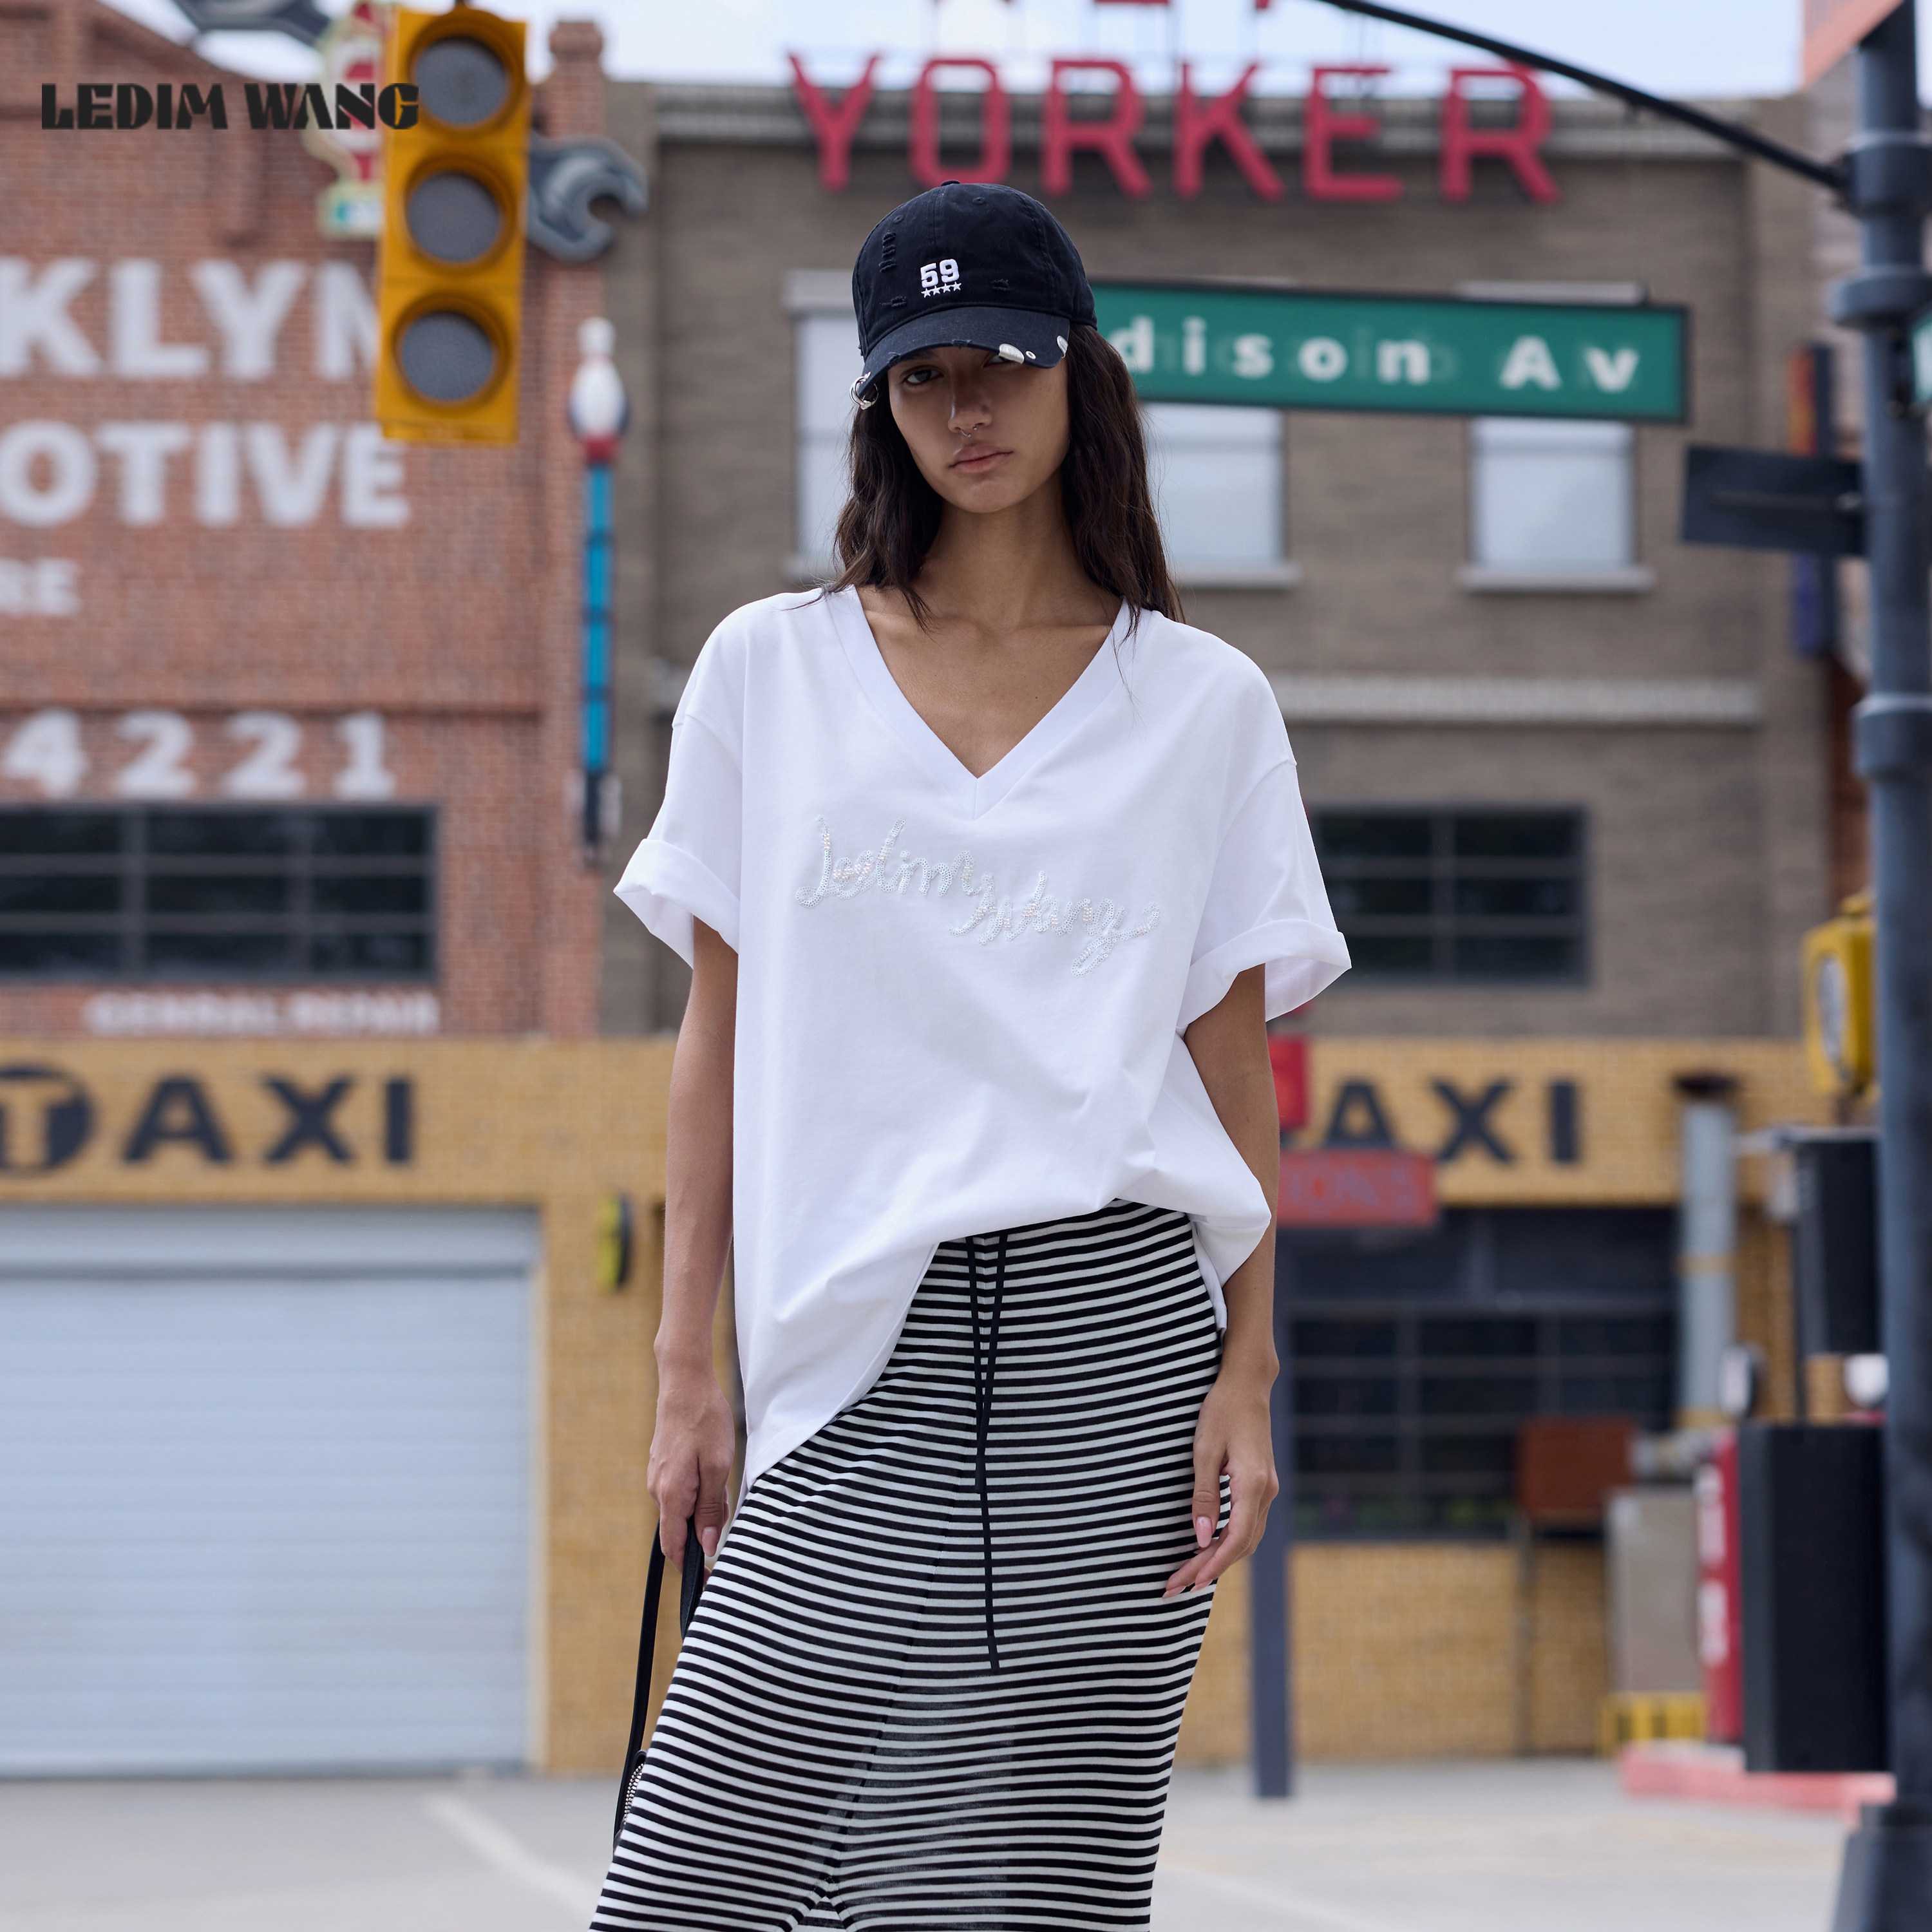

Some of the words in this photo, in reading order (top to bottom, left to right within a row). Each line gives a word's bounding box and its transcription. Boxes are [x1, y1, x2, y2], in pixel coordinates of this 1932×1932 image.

[787, 50, 1557, 198] YORKER
[921, 259, 960, 289] 59
[1497, 334, 1642, 393] Av
[0, 420, 411, 529] OTIVE
[3, 710, 397, 800] 4221
